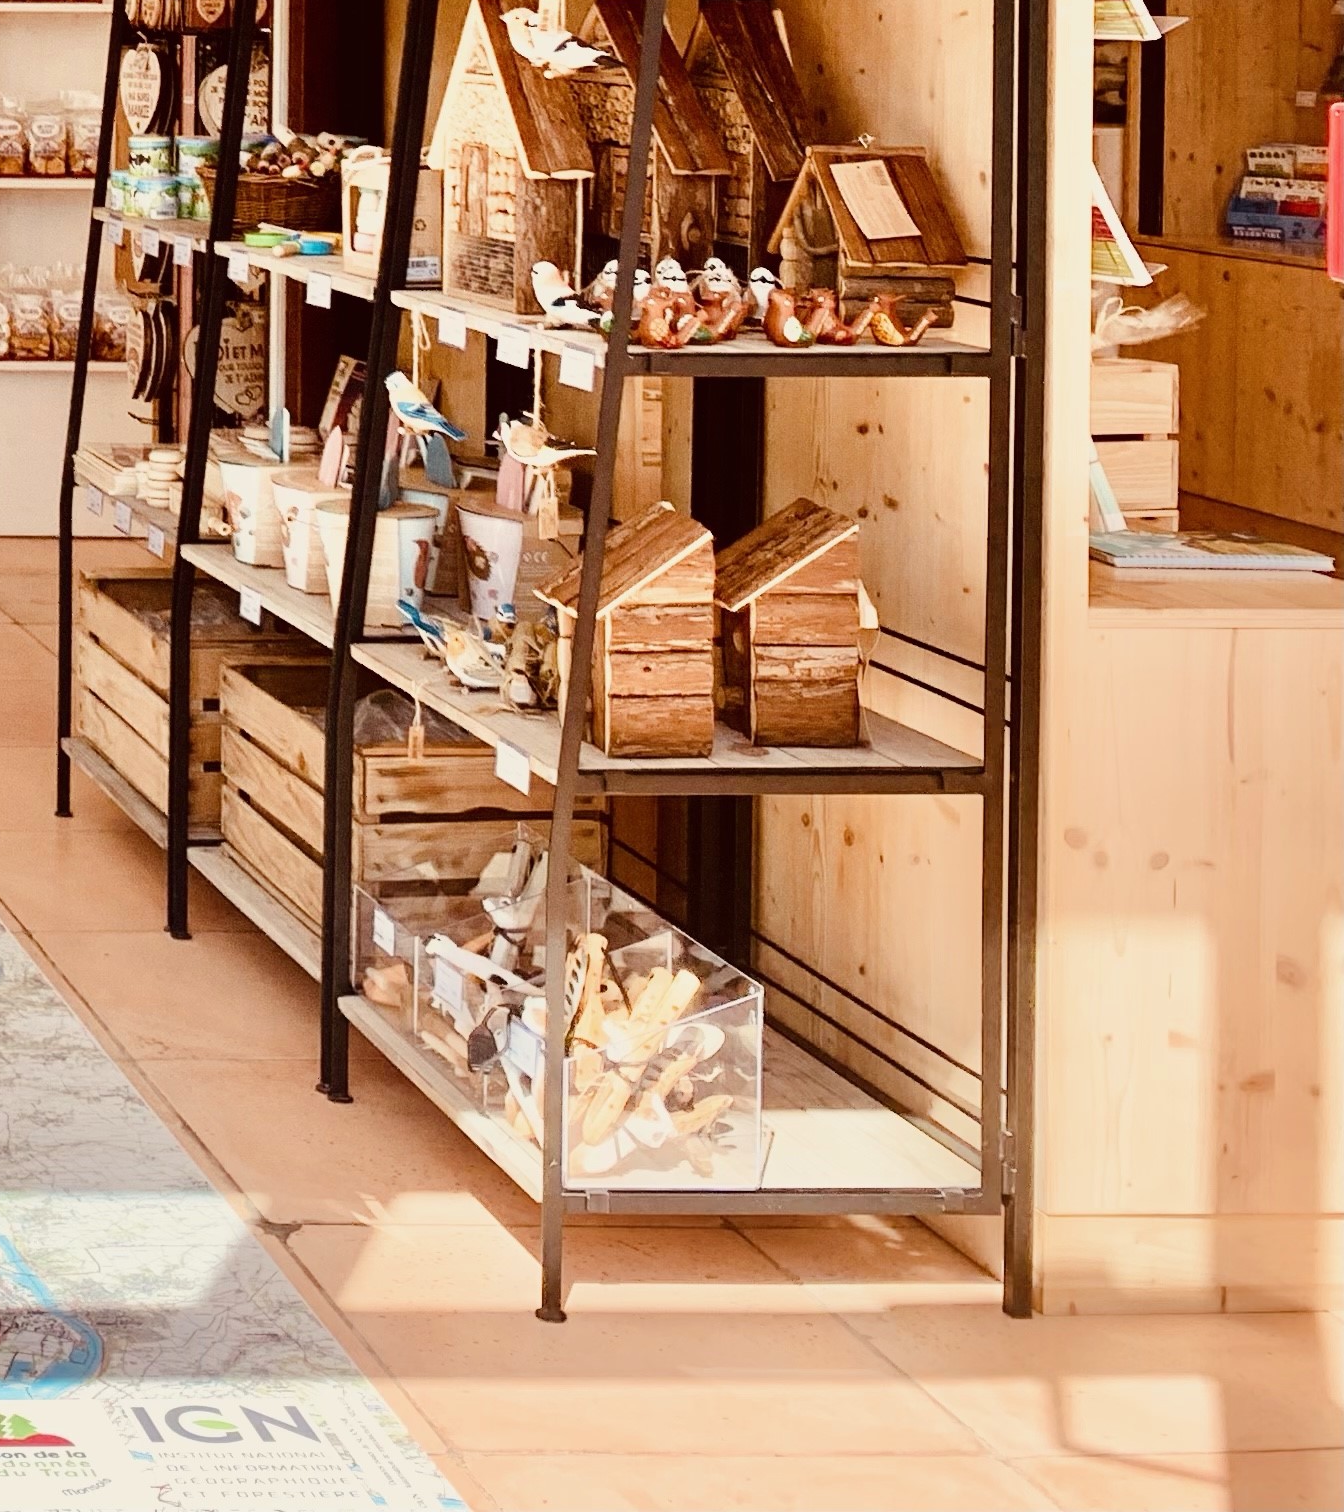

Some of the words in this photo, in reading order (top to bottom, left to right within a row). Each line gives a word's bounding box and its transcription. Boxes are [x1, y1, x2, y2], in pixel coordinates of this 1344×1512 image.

[129, 1404, 322, 1444] IGN
[33, 1450, 61, 1459] de
[65, 1450, 88, 1459] la
[166, 1464, 192, 1472] DE
[39, 1468, 99, 1478] Trail
[182, 1491, 209, 1499] ET
